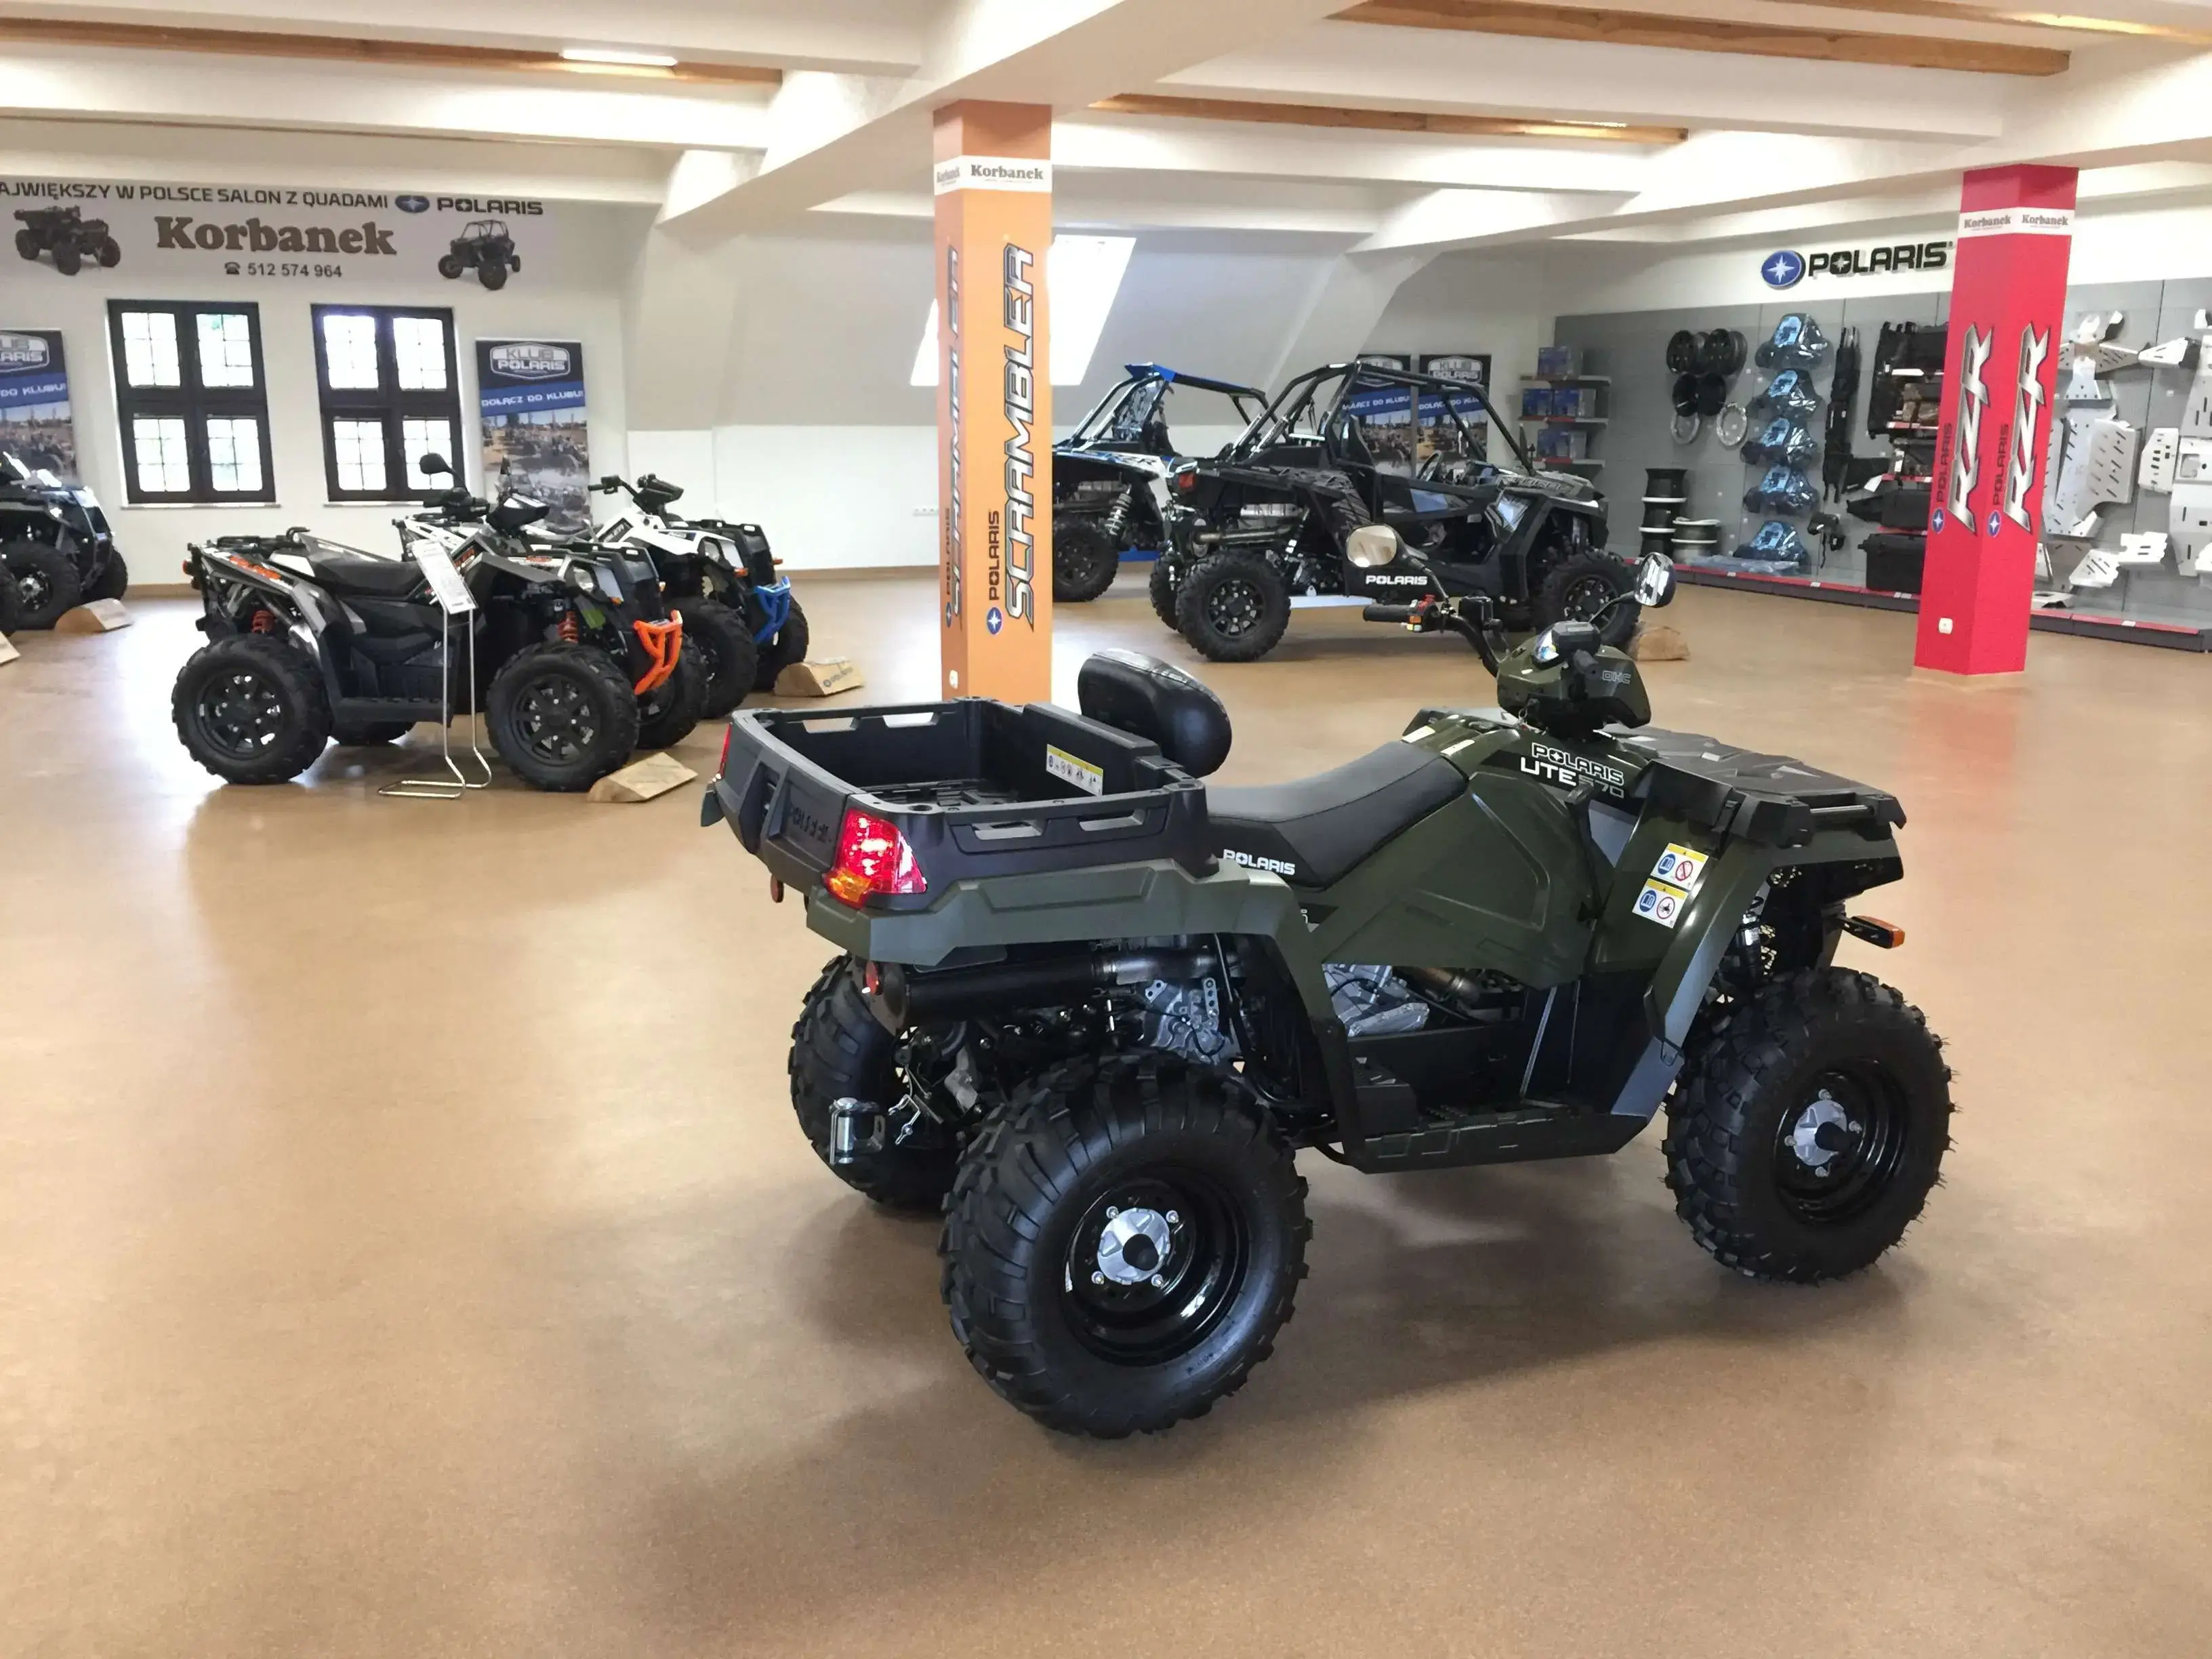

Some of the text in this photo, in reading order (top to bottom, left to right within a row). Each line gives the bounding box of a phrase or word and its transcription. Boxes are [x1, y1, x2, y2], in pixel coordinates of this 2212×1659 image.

[116, 185, 134, 199] W
[140, 186, 213, 202] POLSCE
[218, 188, 281, 204] SALON
[286, 191, 297, 204] Z
[303, 192, 388, 208] QUADAMI
[437, 197, 544, 216] POLARIS
[155, 216, 397, 255] Korbanek
[2022, 214, 2068, 226] Korbanek
[247, 262, 342, 277] 512 574 964
[1808, 241, 1948, 277] POLARIS
[497, 360, 565, 371] POLARIS
[507, 348, 554, 360] KLUB
[527, 394, 543, 403] DO
[1003, 243, 1033, 632] SCRAMBLER
[1948, 322, 1994, 536] RZR
[2004, 321, 2051, 535] RZR
[1936, 423, 1952, 503] POLARIS
[1993, 423, 2009, 506] POLARIS
[989, 510, 1000, 601] POLARIS
[1366, 575, 1428, 586] POLARIS
[1532, 742, 1624, 786] POLARIS
[1223, 848, 1295, 876] POLARIS
